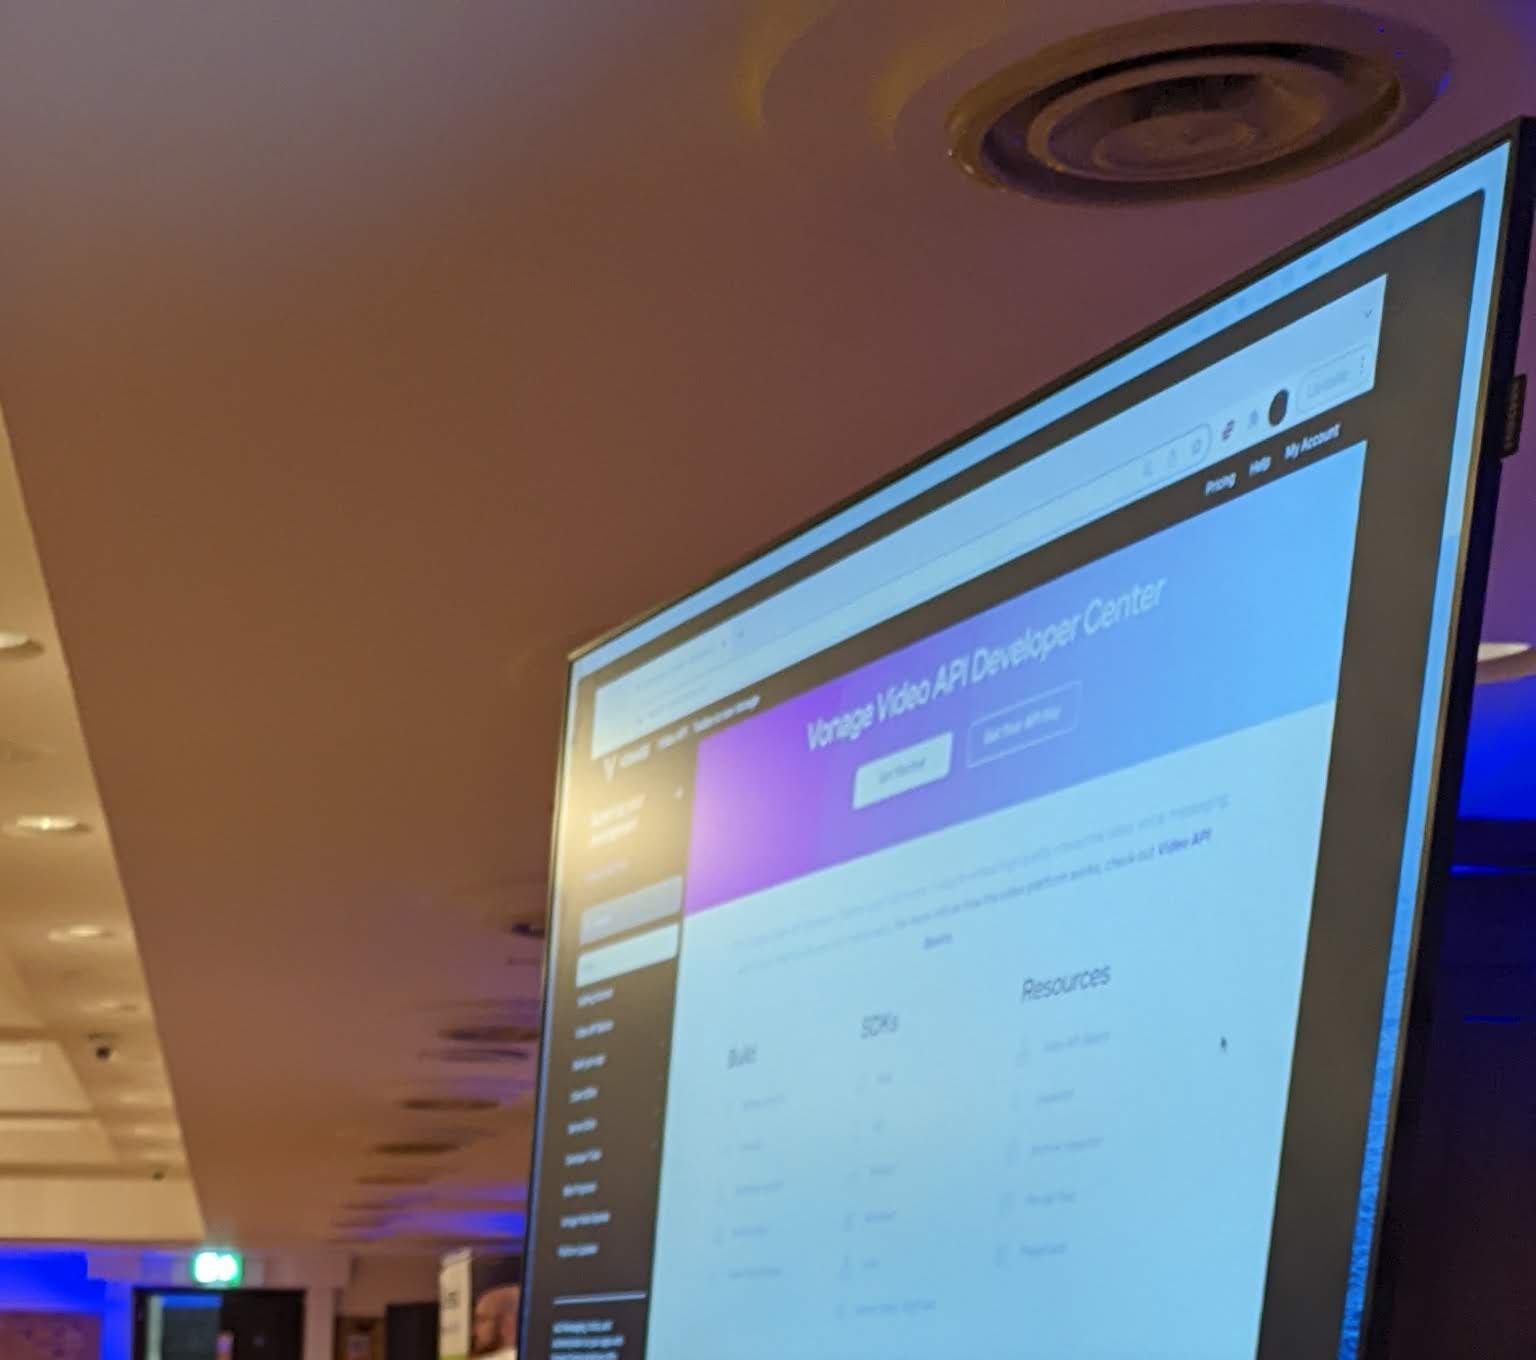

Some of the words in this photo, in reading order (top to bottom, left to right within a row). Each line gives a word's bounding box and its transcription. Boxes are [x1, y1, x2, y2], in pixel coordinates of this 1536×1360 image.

[1300, 423, 1341, 451] Account
[805, 702, 873, 750] Vonage
[875, 677, 931, 722] Video
[932, 658, 966, 698] API
[971, 612, 1081, 683] Developer
[1083, 579, 1167, 636] Center
[1021, 965, 1112, 1003] Resources
[861, 1013, 898, 1039] SDKs
